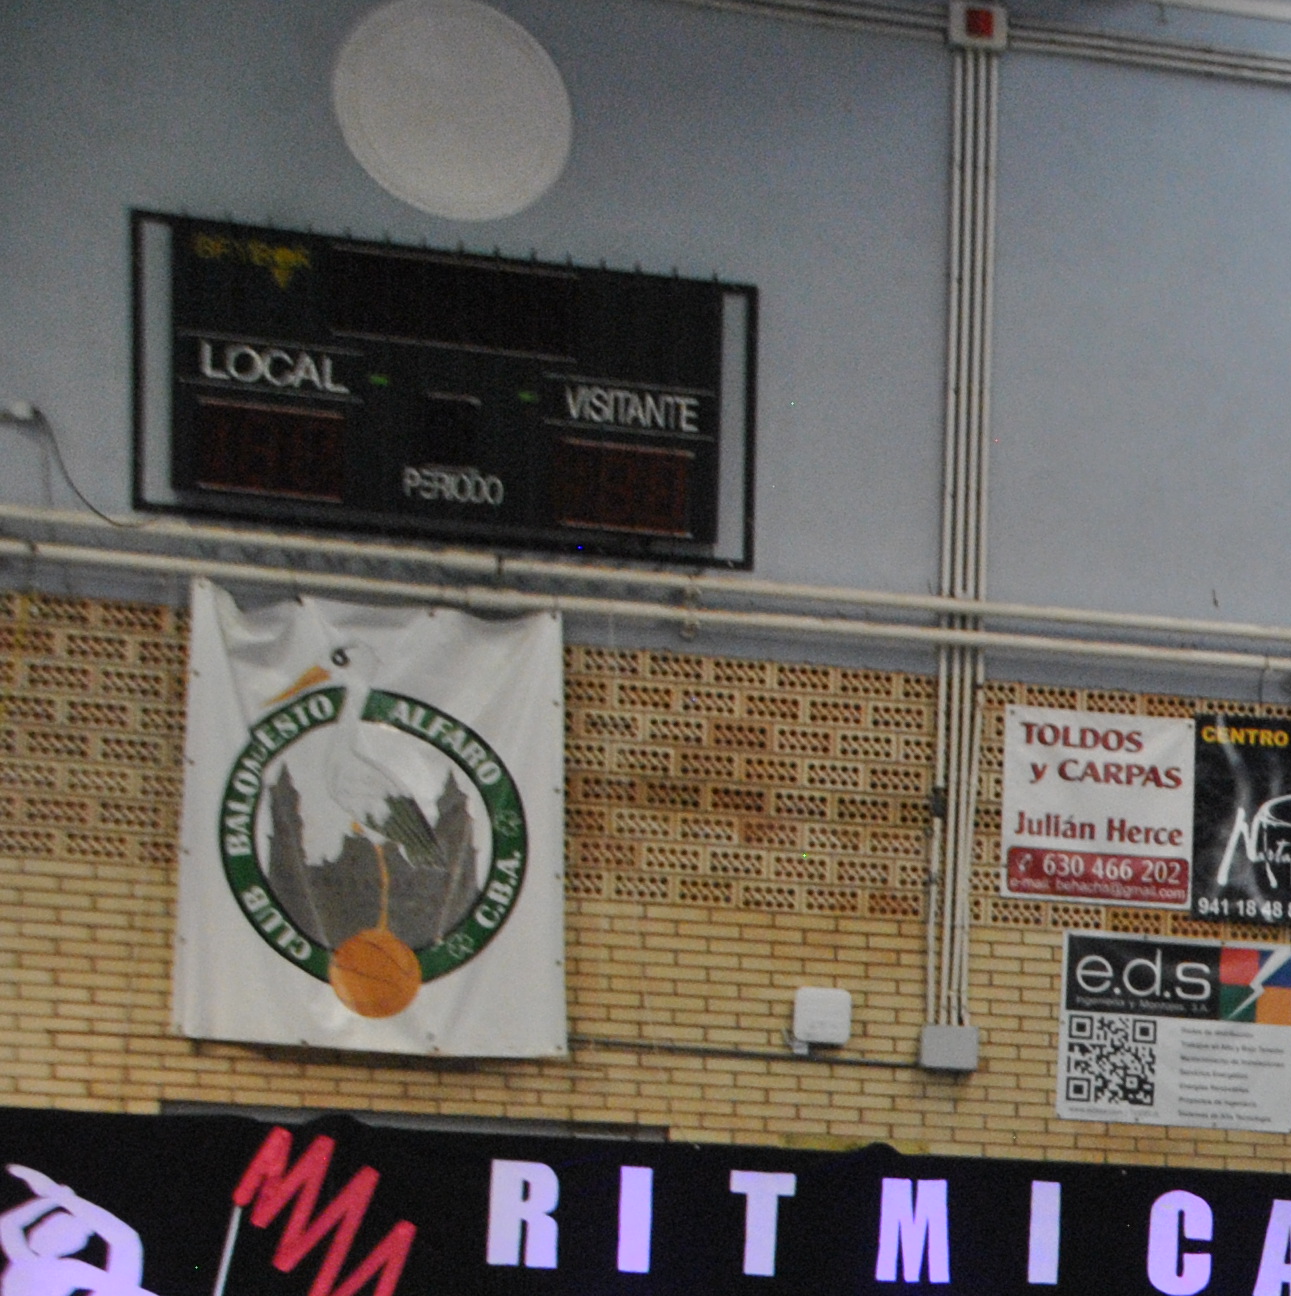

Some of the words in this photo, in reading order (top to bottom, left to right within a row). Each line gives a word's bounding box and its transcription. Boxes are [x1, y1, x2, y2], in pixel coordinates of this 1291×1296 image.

[201, 338, 350, 395] LOCAL
[564, 382, 698, 433] VISITANTE
[403, 466, 504, 506] PERIODO
[391, 700, 501, 786] ALFARO
[1021, 721, 1144, 753] TOLDOS
[1201, 725, 1290, 747] CENTRO
[1029, 762, 1047, 784] y
[1057, 758, 1183, 789] CARPAS
[1014, 811, 1096, 841] Julián
[1106, 817, 1183, 846] Herce
[1042, 853, 1085, 876] 630
[1091, 857, 1134, 881] 466
[1141, 860, 1181, 885] 202
[240, 885, 313, 961] CLUB
[1198, 896, 1230, 915] 941
[1237, 899, 1257, 916] 18
[1260, 900, 1283, 919] 48
